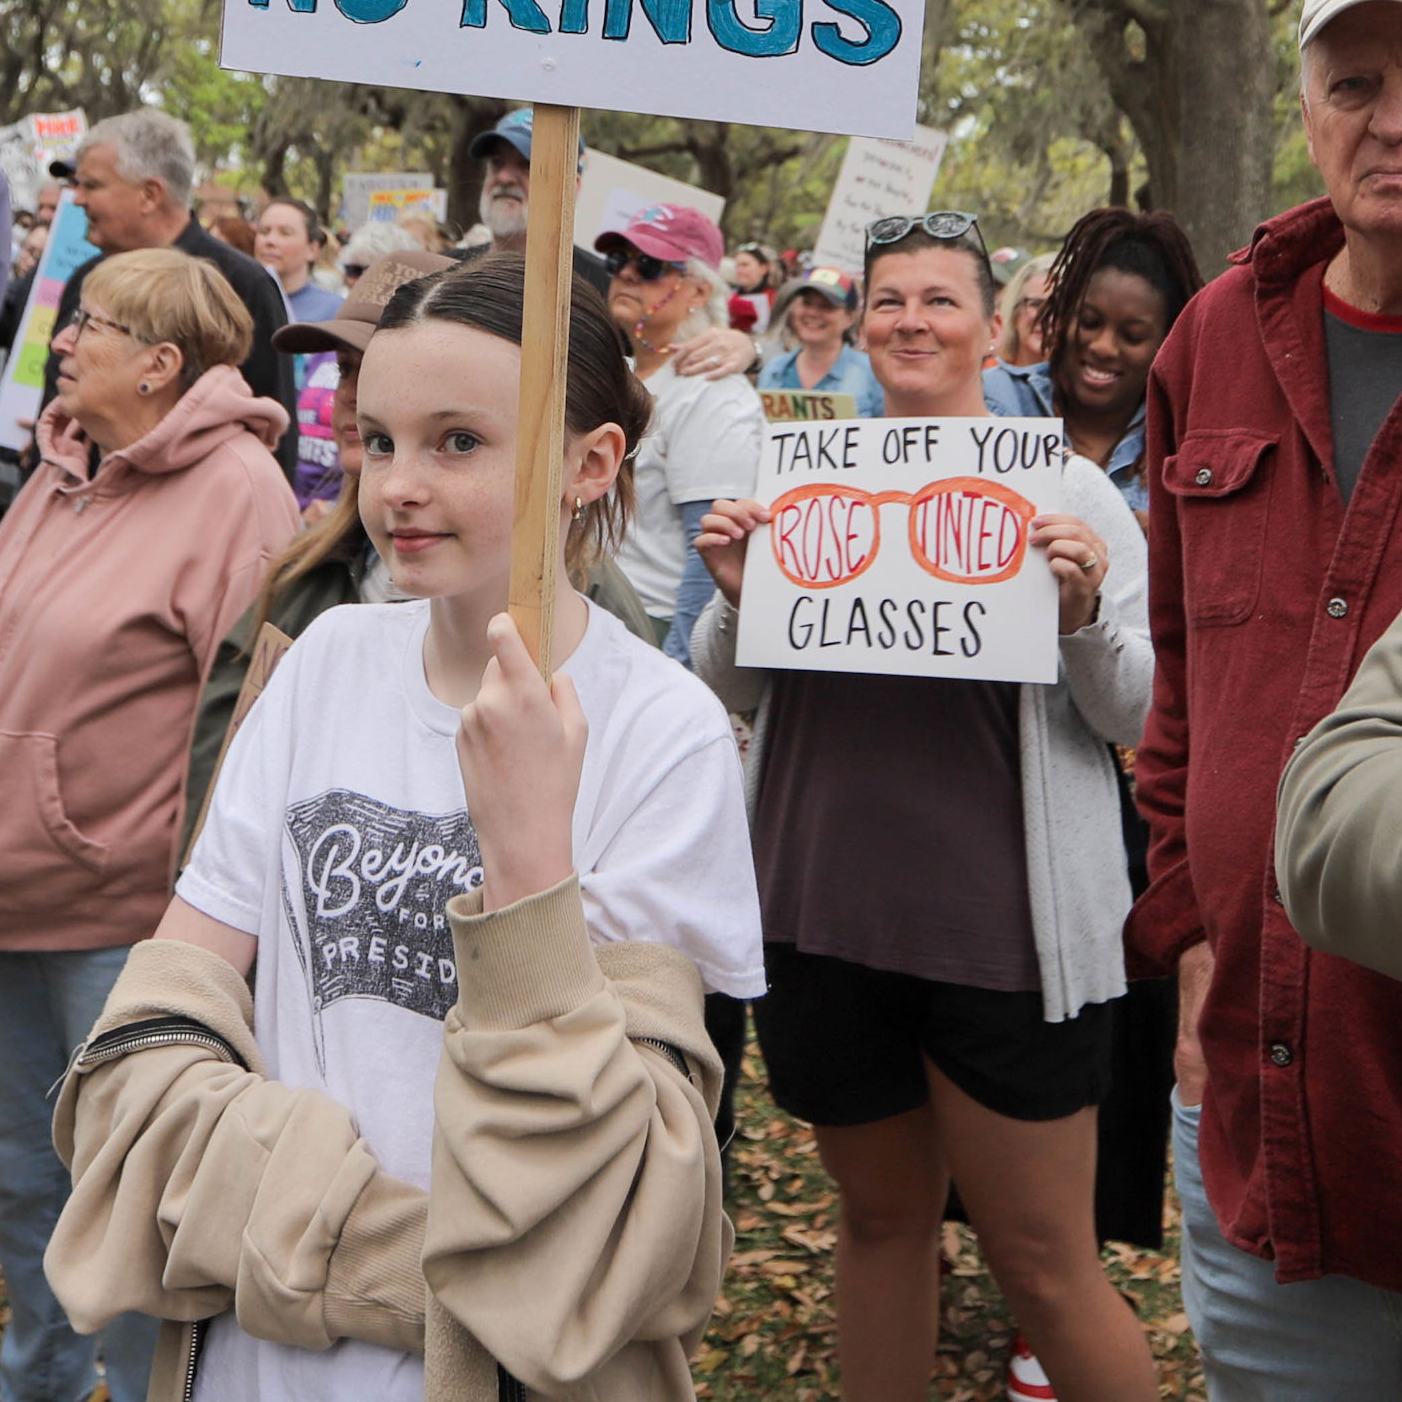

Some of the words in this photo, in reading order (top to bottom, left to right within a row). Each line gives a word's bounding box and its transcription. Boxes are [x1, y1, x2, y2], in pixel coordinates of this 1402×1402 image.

[761, 394, 835, 420] RANTS
[771, 427, 861, 475] TAKE
[883, 425, 940, 465] OFF
[970, 426, 1061, 474] YOUR
[779, 495, 865, 580] ROSE
[917, 491, 1023, 574] TINTED
[788, 596, 986, 658] GLASSES
[399, 908, 445, 930] FOR
[322, 936, 457, 984] PRESID
